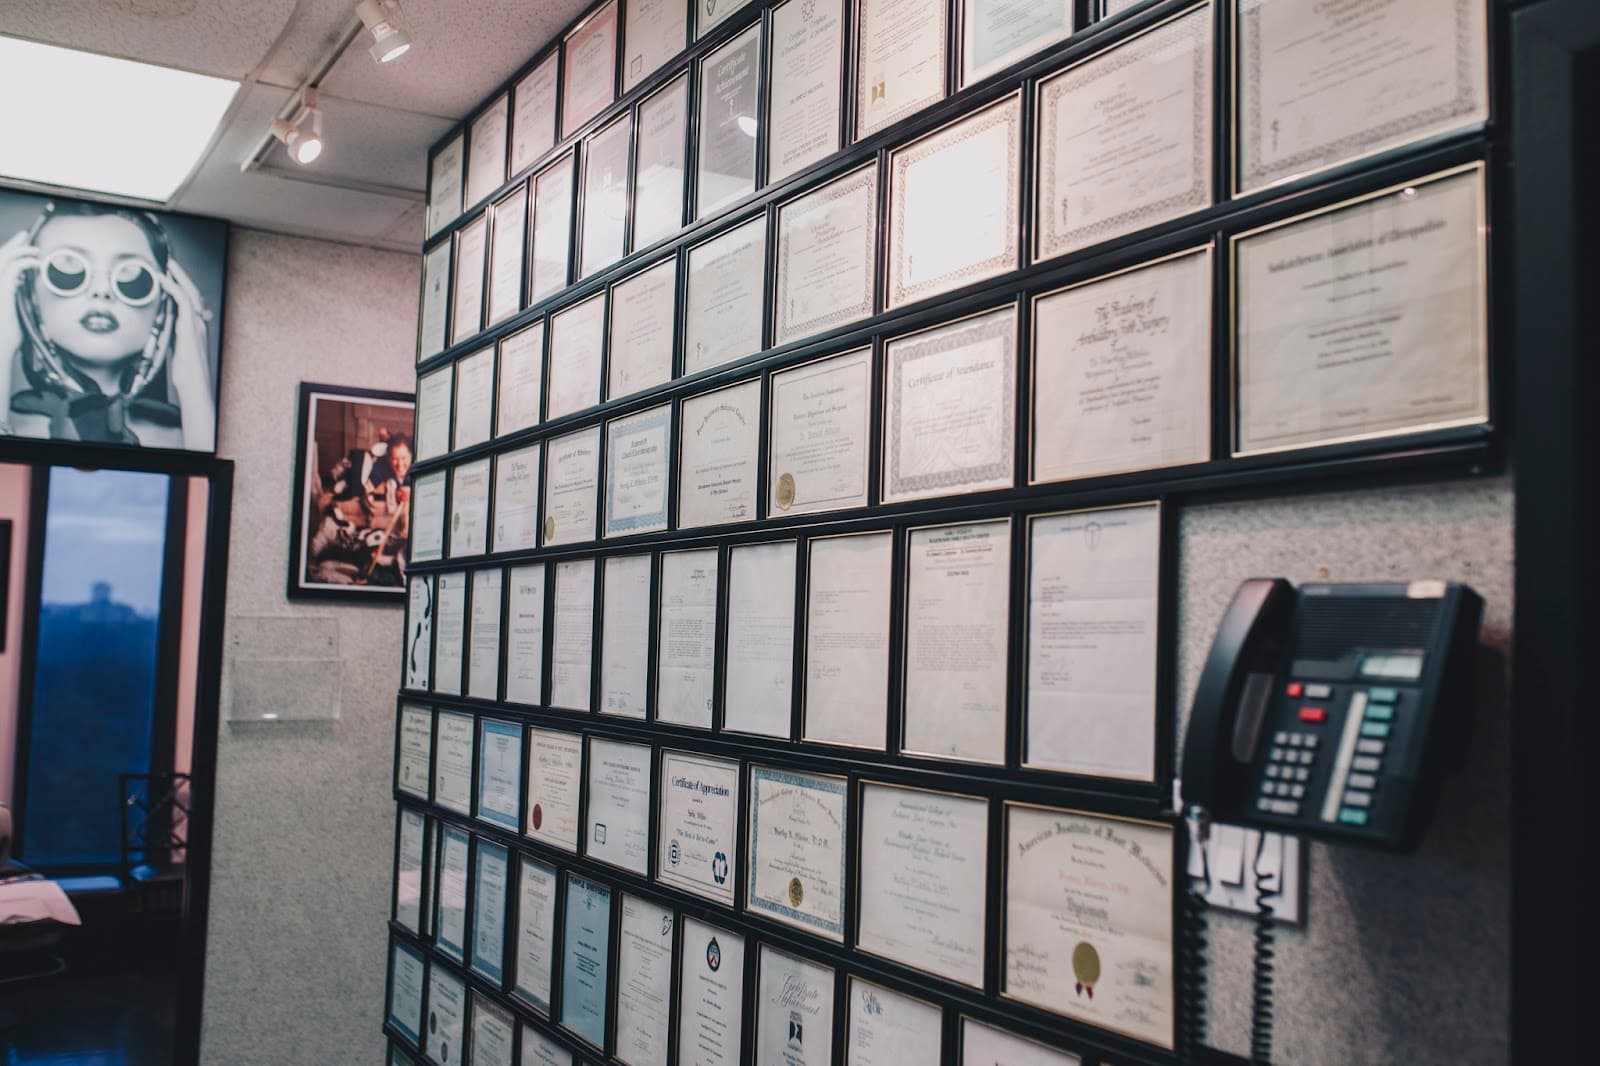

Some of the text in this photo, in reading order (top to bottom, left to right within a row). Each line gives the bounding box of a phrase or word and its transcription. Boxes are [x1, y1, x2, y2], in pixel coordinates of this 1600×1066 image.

[908, 373, 945, 389] Certificate
[957, 360, 995, 376] Attendance
[672, 775, 694, 790] Certificate
[700, 782, 730, 797] Appreciation
[1018, 829, 1053, 856] American
[1055, 821, 1092, 836] Institute
[1094, 826, 1102, 838] of
[1104, 826, 1127, 848] Foot
